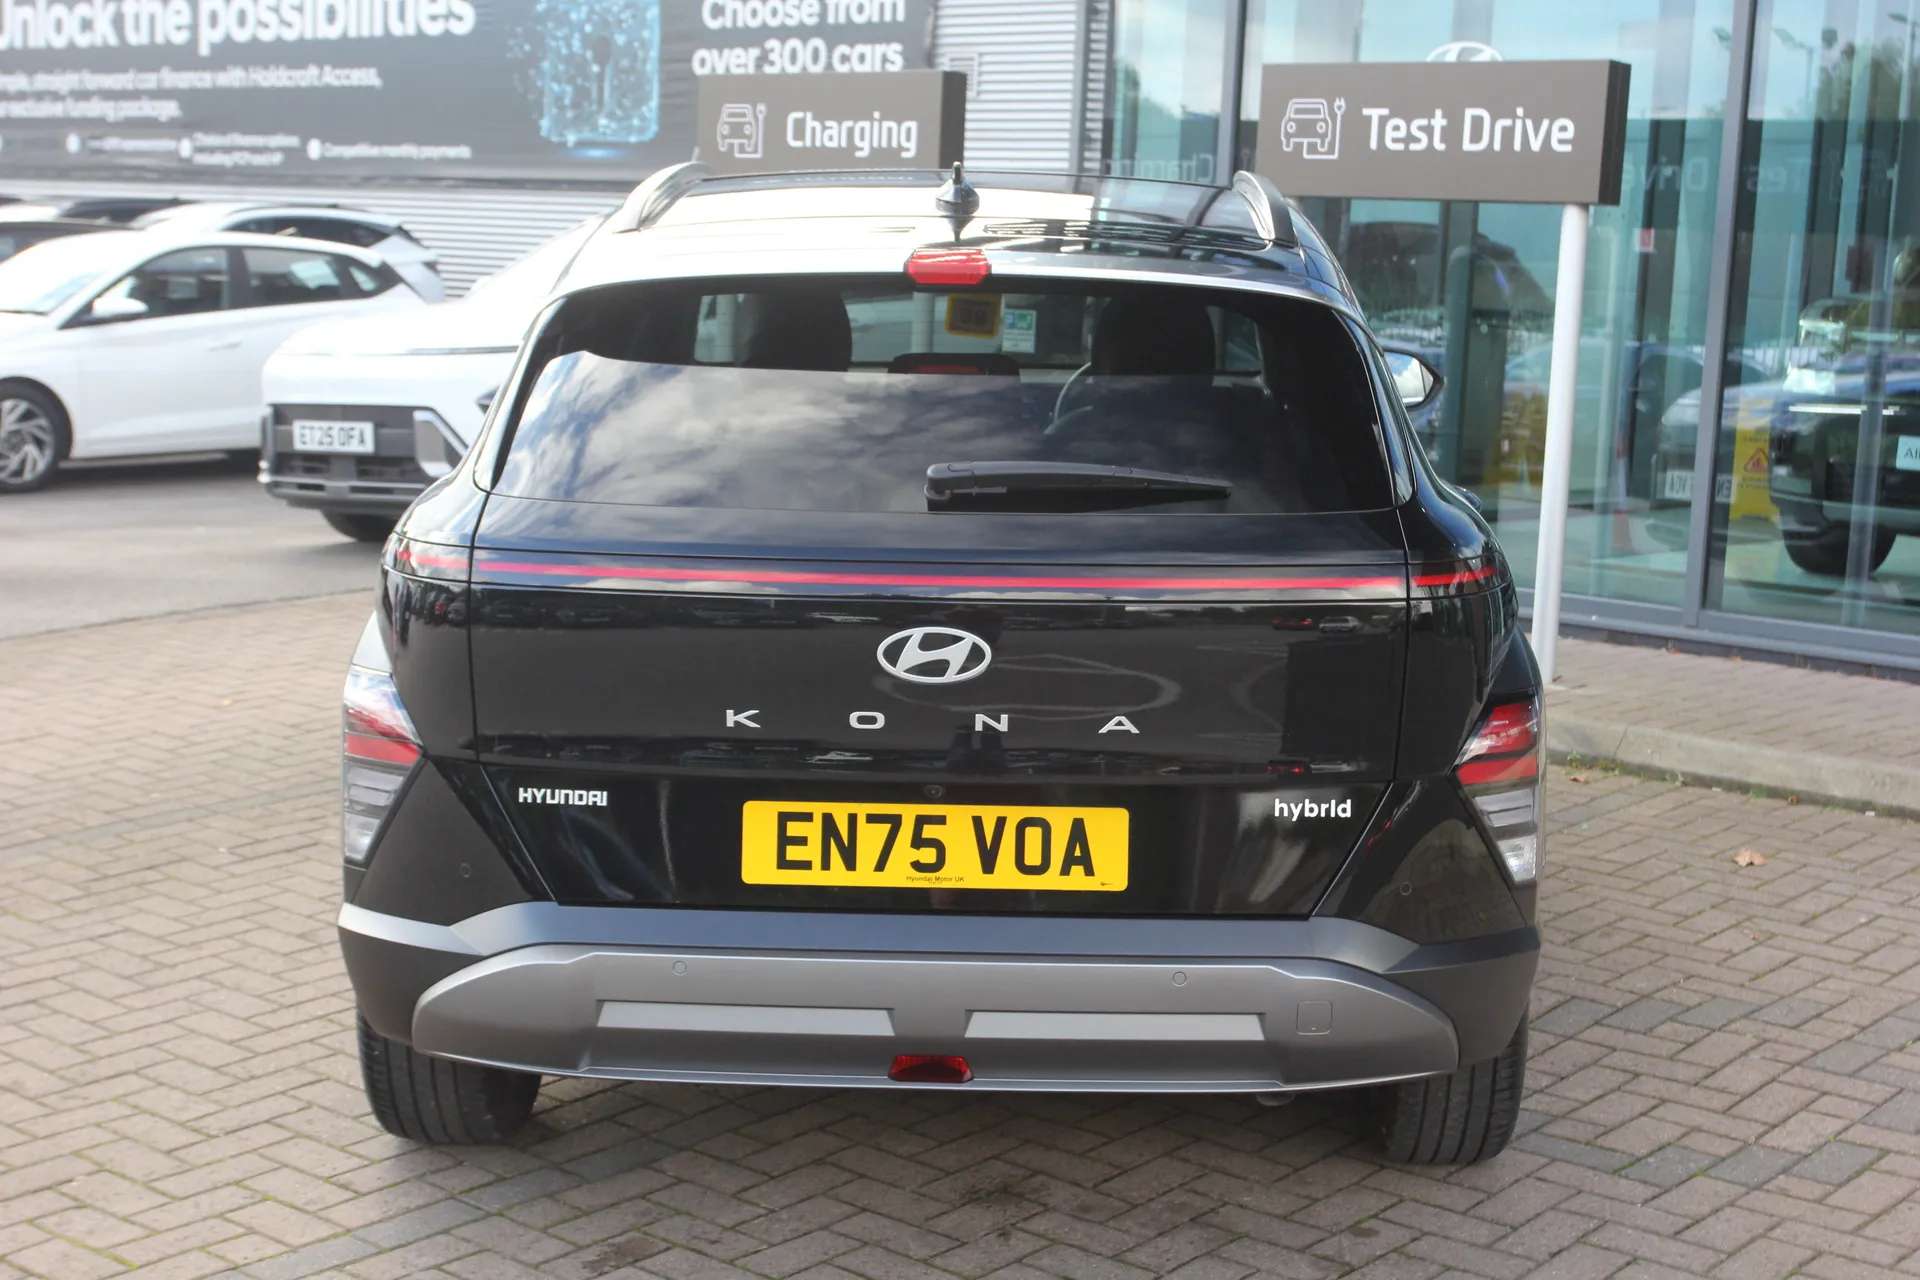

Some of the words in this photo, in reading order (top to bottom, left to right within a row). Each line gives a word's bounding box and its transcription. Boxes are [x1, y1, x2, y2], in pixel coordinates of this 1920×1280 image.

[122, 0, 192, 46] the
[198, 0, 476, 56] possibilities
[701, 0, 820, 29] Choose
[826, 0, 906, 24] from
[692, 47, 759, 76] over
[762, 37, 827, 74] 300
[831, 41, 904, 72] cars
[786, 111, 918, 157] Charging
[1362, 107, 1448, 150] Test
[1462, 107, 1576, 152] Drive
[725, 709, 1140, 734] KONA
[518, 787, 608, 806] HYUNDAI
[1274, 798, 1352, 822] hybrid
[776, 811, 947, 874] EN75
[970, 815, 1096, 876] VOA
